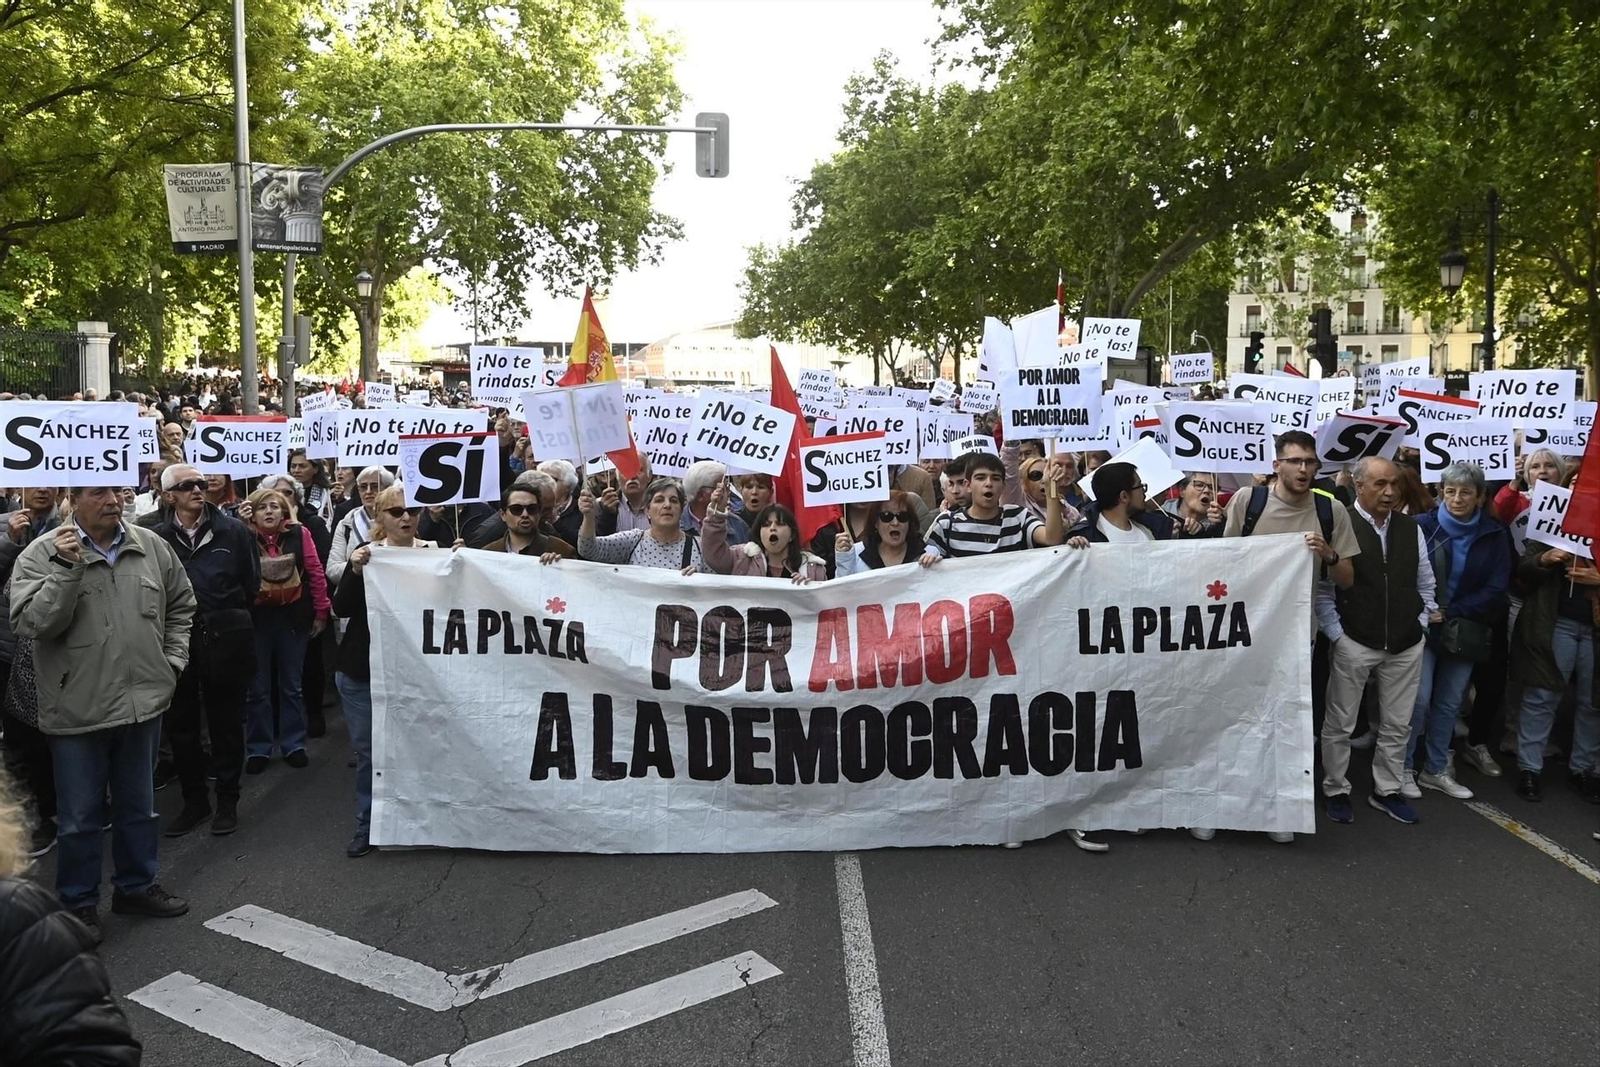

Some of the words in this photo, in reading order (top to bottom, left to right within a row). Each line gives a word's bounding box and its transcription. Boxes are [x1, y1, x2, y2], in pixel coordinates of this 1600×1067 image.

[175, 171, 222, 179] PROGRAMA
[177, 186, 227, 194] CULTURALES
[256, 243, 317, 252] centenariopalacios.es
[1086, 323, 1111, 337] ¡No
[1115, 324, 1130, 337] te
[477, 353, 507, 371] ¡No
[513, 355, 531, 369] te
[1085, 348, 1099, 360] te
[1173, 359, 1193, 370] ¡No
[1195, 358, 1206, 367] te
[1408, 364, 1420, 376] te
[478, 373, 537, 389] rindas!
[800, 371, 818, 381] ¡No
[820, 372, 830, 383] te
[1018, 369, 1043, 386] POR
[1045, 368, 1080, 386] AMOR
[1175, 368, 1210, 379] rindas!
[367, 386, 381, 395] ¡No
[800, 381, 832, 394] rindas!
[963, 390, 980, 400] ¡No
[982, 392, 991, 401] te
[1490, 379, 1528, 399] ¡No
[1535, 379, 1560, 396] te
[963, 401, 993, 411] rindas!
[1037, 388, 1045, 406] A
[1047, 388, 1061, 406] LA
[1135, 395, 1149, 404] te
[675, 406, 692, 418] te
[700, 400, 746, 426] ¡No
[752, 413, 778, 434] te
[819, 405, 830, 418] te
[1012, 408, 1089, 427] DEMOCRACIA
[1291, 409, 1312, 428] SÍ
[1491, 401, 1567, 419] rindas!
[344, 417, 381, 438] ¡No
[410, 418, 447, 435] ¡No
[453, 420, 475, 434] te
[843, 416, 878, 435] ¡No
[884, 417, 904, 433] te
[3, 416, 130, 470] SÁNCHEZ
[200, 426, 282, 463] SÁNCHEZ
[645, 426, 677, 445] ¡No
[681, 433, 689, 447] t
[696, 426, 780, 462] rindas!
[961, 441, 974, 450] POR
[973, 439, 989, 449] AMOR
[1174, 414, 1265, 458] SÁNCHEZ
[345, 439, 399, 457] rinda
[1424, 432, 1508, 470] SÁNCHEZ
[646, 448, 691, 469] rinda
[804, 449, 882, 493] SÁNCHEZ
[422, 608, 469, 655] LA
[477, 608, 589, 665] PLAZA
[1077, 605, 1126, 655] LA
[1132, 600, 1252, 653] PLAZA
[651, 604, 794, 693] POR
[807, 593, 1017, 694] AMOR
[529, 691, 577, 781] A
[591, 693, 676, 781] LA
[684, 690, 1143, 786] DEMOCRACIA
